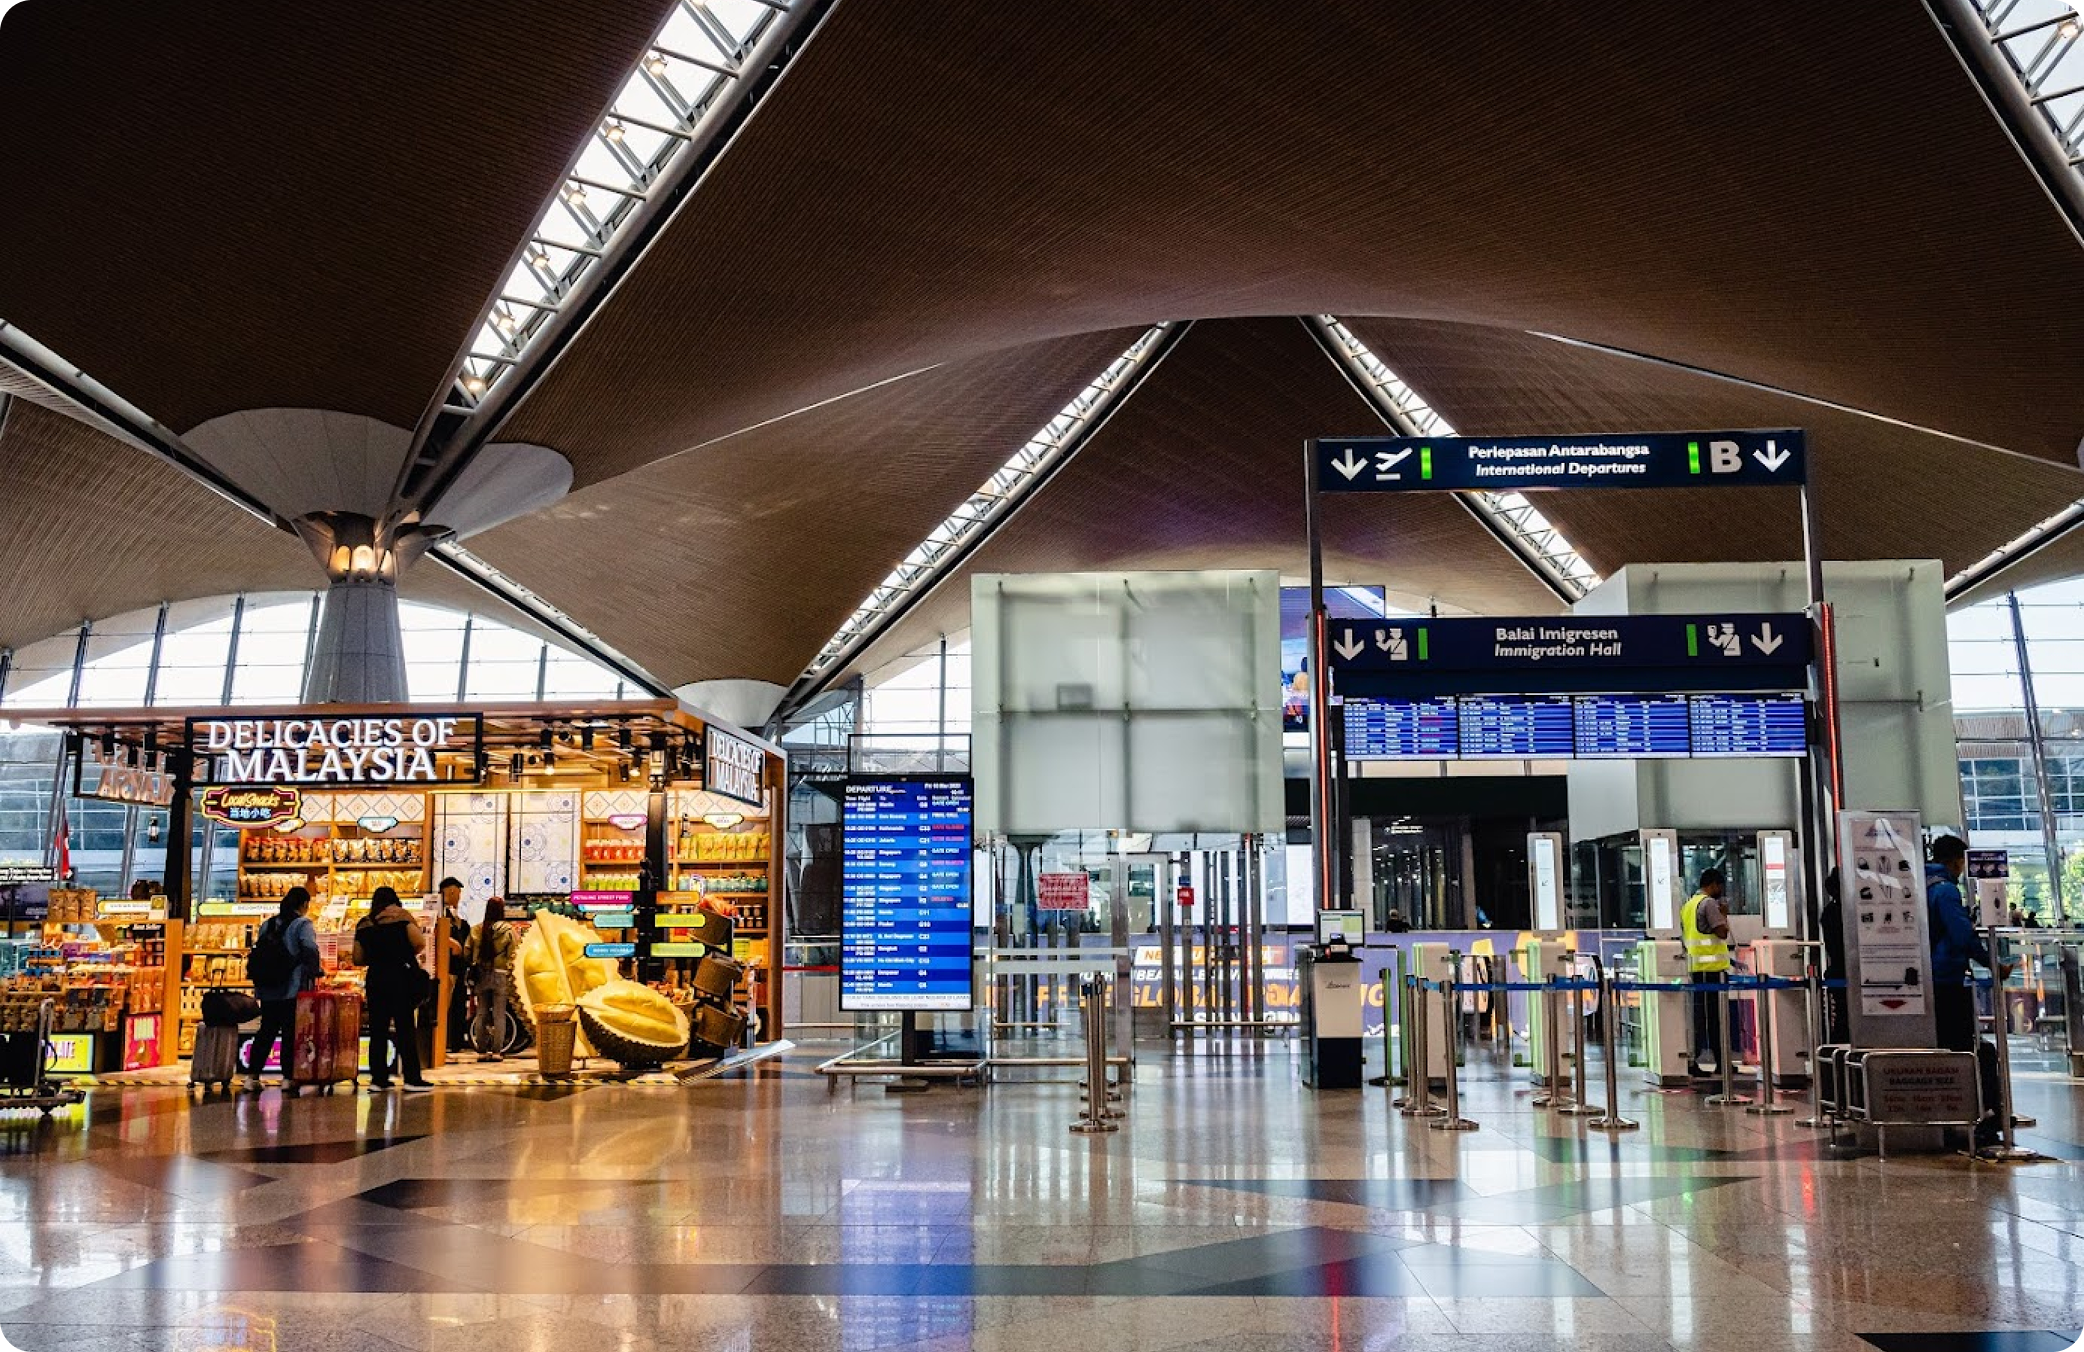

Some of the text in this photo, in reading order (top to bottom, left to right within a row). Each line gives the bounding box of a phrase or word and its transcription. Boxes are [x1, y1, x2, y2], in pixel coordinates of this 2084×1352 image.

[1468, 443, 1650, 460] Perlepasan Antarabangsa
[1709, 440, 1742, 474] B
[1476, 462, 1647, 477] International Departures
[1496, 627, 1619, 644] Balai Imigresen
[1495, 642, 1622, 660] Immigration Hall
[208, 717, 459, 749] DELICACIES OF
[225, 747, 438, 782] MALAYSIA
[845, 784, 893, 794] DEPARTURE
[220, 792, 281, 808] Local Snacks
